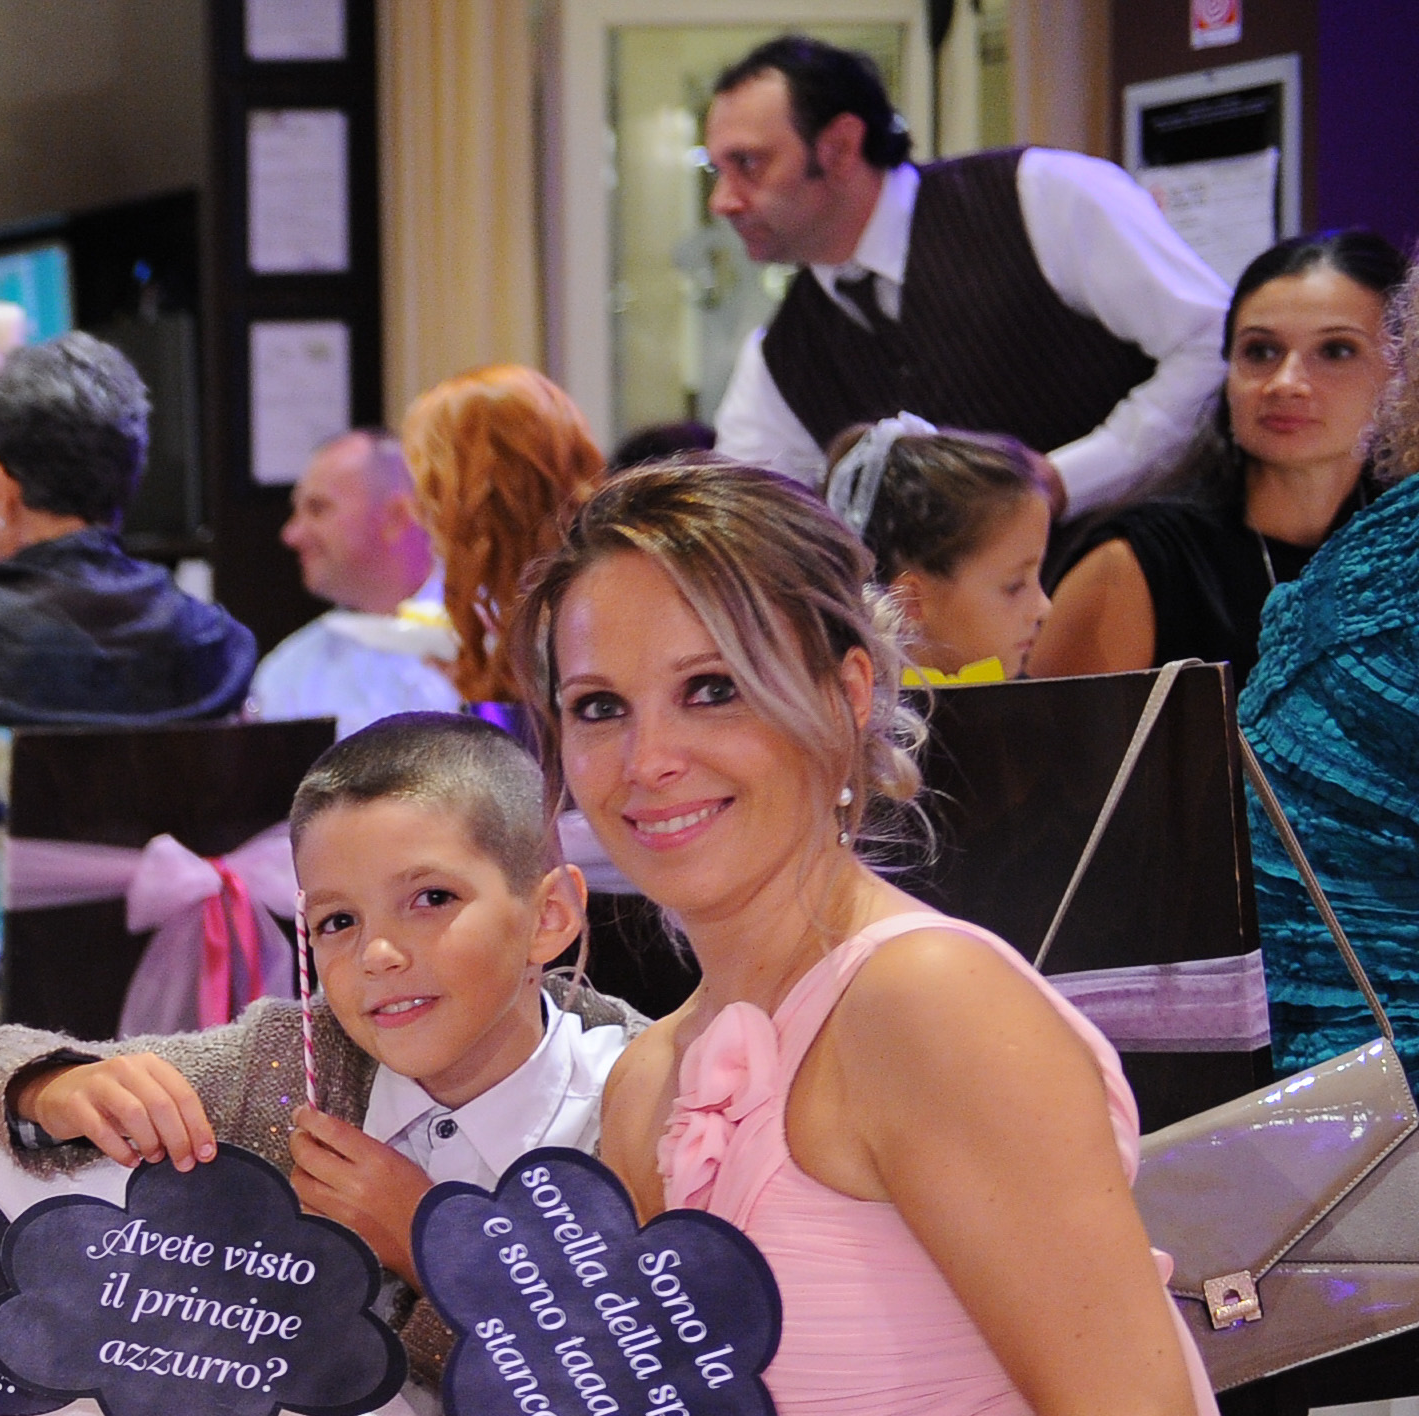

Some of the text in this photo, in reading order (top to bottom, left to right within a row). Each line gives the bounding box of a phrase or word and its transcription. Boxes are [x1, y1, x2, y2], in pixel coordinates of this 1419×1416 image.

[86, 1219, 315, 1284] Avete visto
[483, 1217, 512, 1237] e
[499, 1243, 566, 1330] sono
[521, 1167, 608, 1287] sorella
[595, 1293, 662, 1380] della
[101, 1272, 302, 1344] il principe
[638, 1250, 734, 1389] Sono la
[99, 1340, 288, 1392] azzurro?
